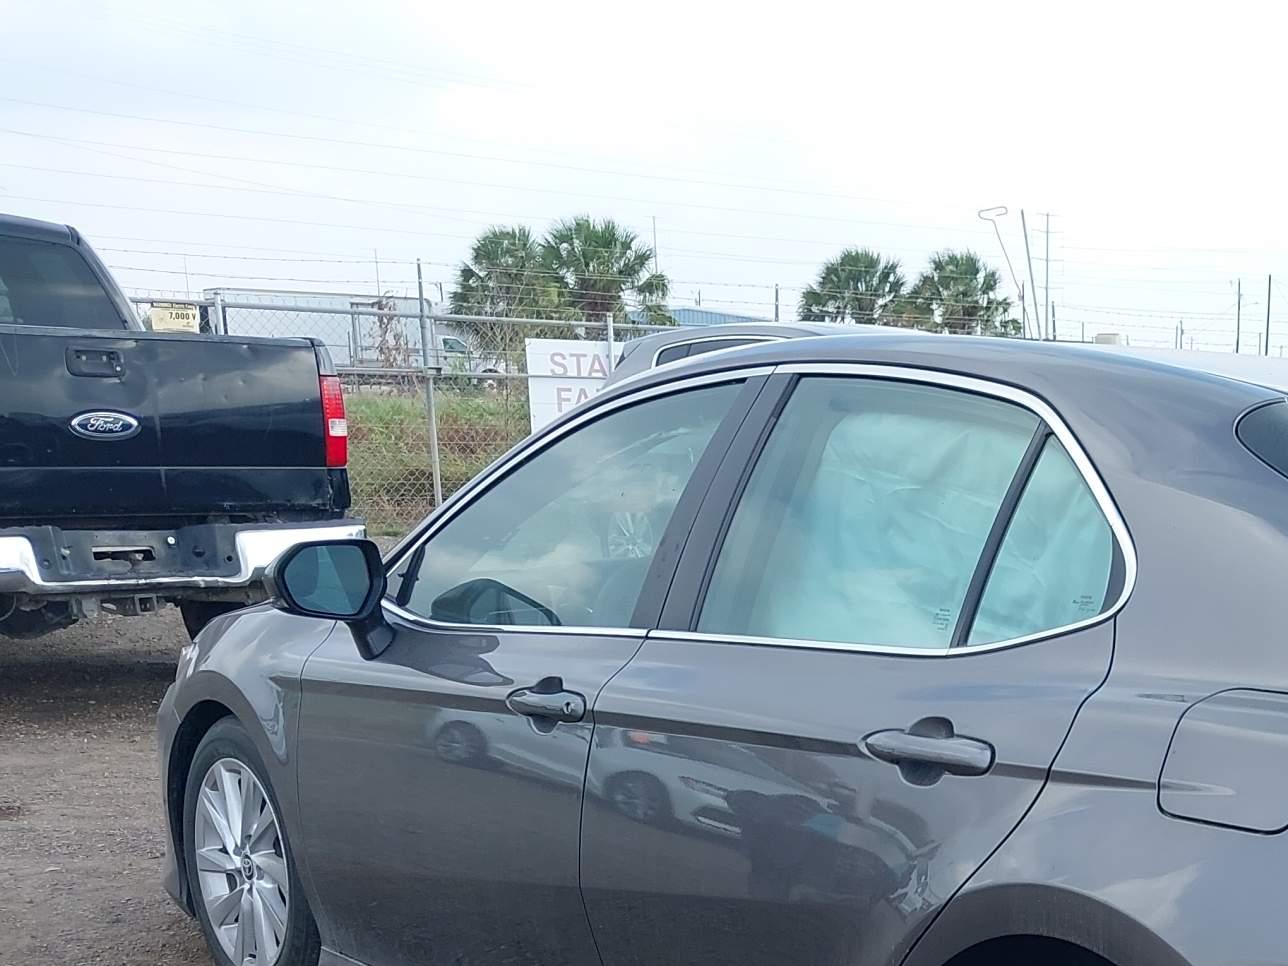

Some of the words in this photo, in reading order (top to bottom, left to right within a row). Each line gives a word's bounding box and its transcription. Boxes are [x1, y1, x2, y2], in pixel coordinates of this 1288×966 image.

[169, 311, 190, 321] 7,000
[556, 386, 602, 413] FA
[87, 416, 124, 432] Ford
